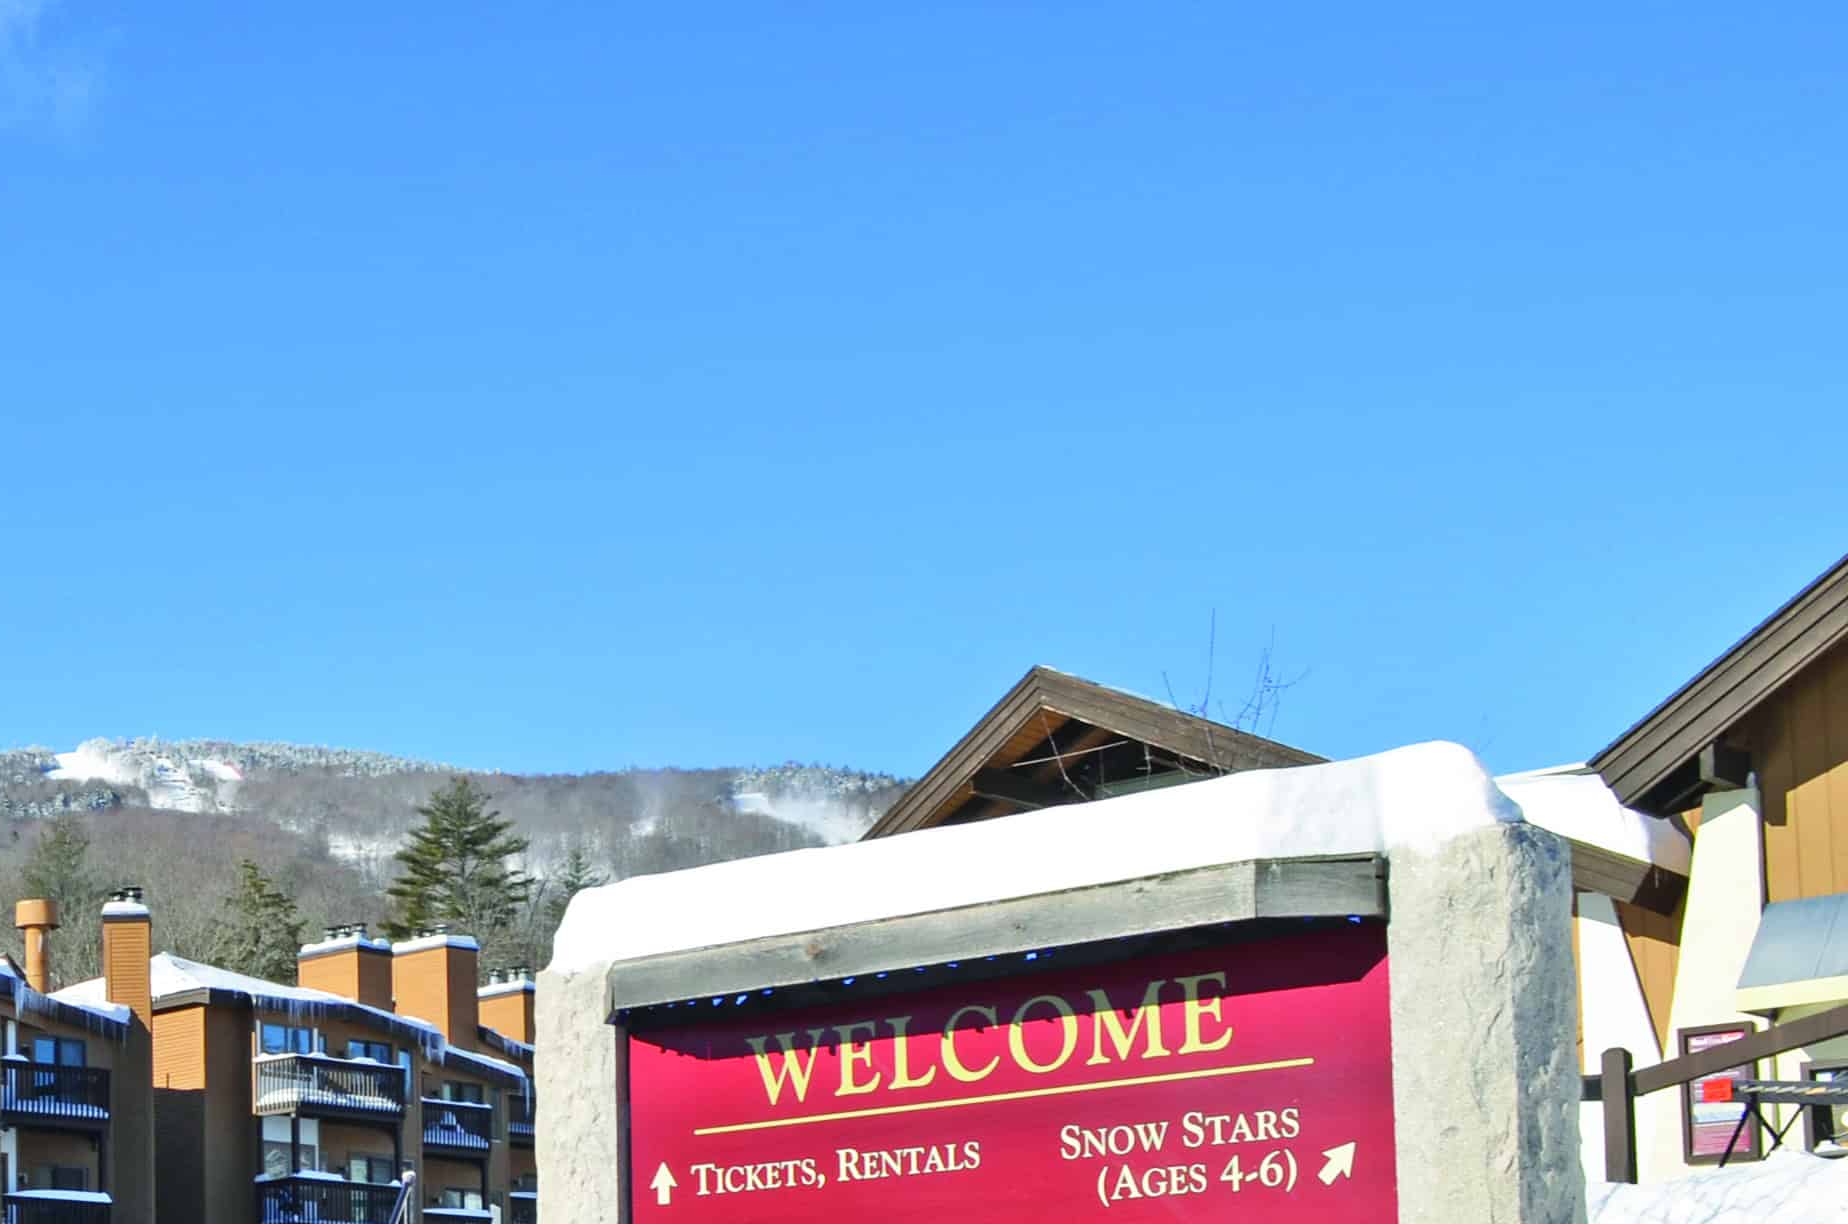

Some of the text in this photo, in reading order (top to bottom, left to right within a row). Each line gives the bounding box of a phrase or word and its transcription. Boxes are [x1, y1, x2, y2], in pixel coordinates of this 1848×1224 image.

[747, 970, 1234, 1107] WELCOME
[1060, 1107, 1300, 1160] SNOW STARS
[690, 1141, 981, 1196] TICKETS, RENTALS
[1097, 1148, 1298, 1208] (AGES 4-6)
